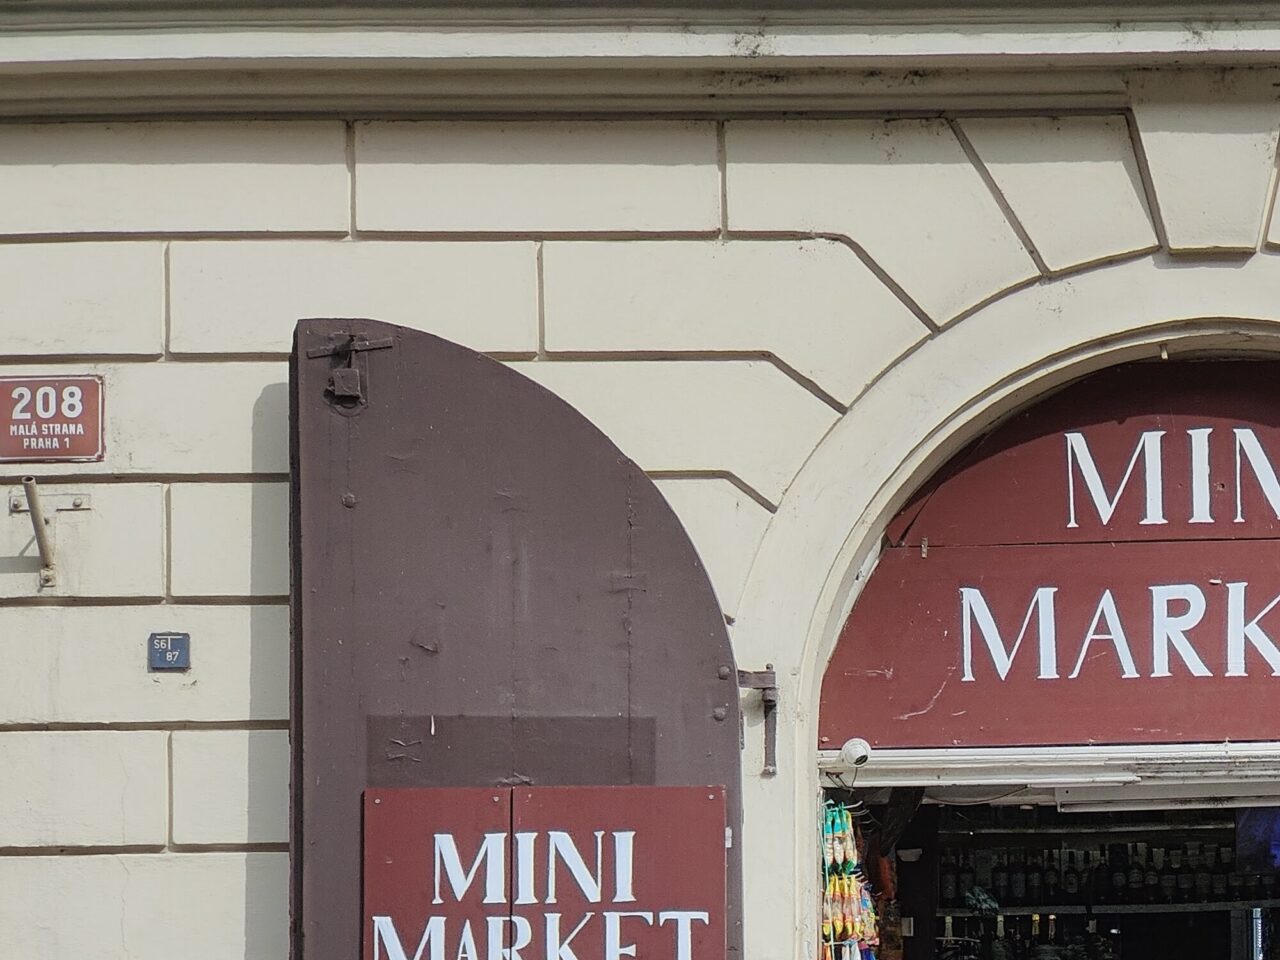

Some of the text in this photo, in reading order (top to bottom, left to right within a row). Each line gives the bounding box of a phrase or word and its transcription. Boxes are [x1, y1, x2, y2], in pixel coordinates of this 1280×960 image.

[12, 386, 82, 419] 208
[10, 421, 83, 435] MALÁ STRANA
[24, 438, 69, 448] PRAHA 1
[166, 651, 179, 662] 87
[432, 831, 636, 904] MINI
